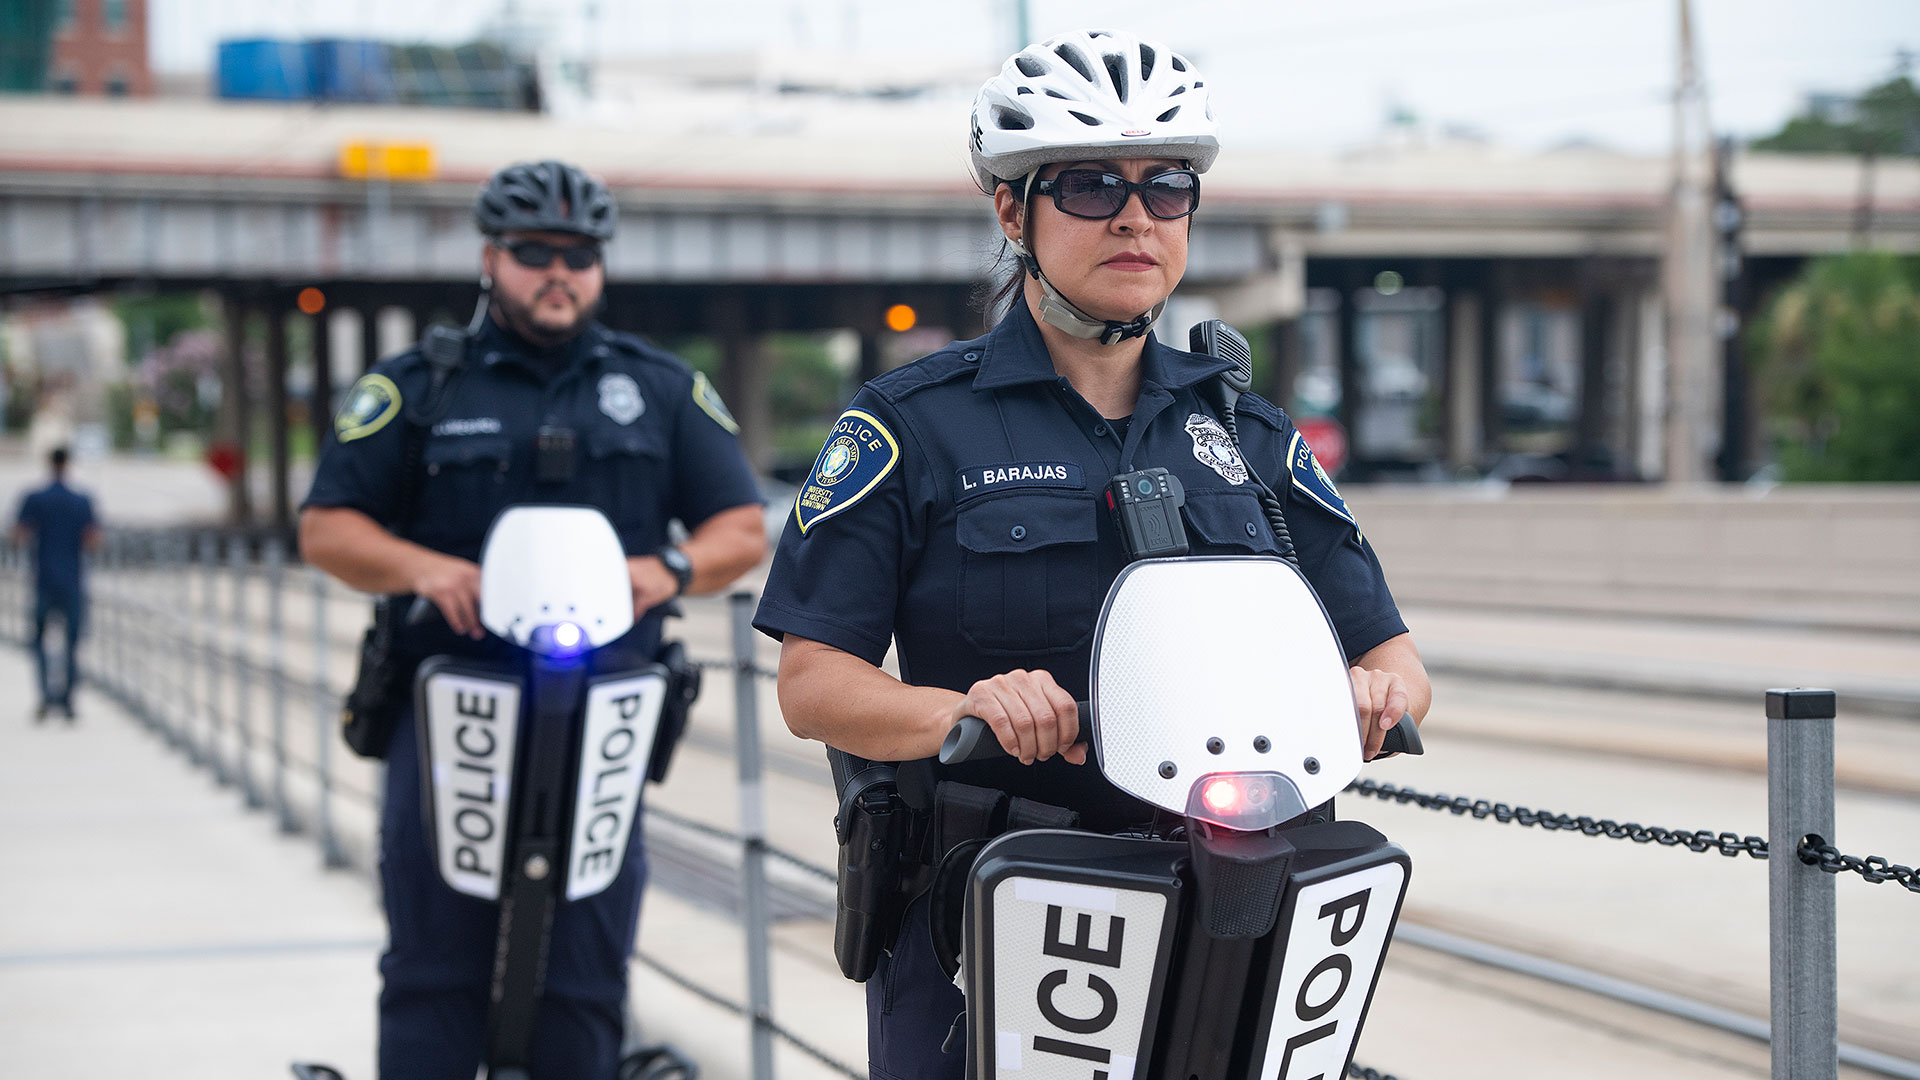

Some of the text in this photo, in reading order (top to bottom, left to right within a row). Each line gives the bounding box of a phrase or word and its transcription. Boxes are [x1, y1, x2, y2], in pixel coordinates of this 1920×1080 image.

[832, 421, 882, 452] POLICE
[962, 465, 1067, 490] L. BARAJAS
[454, 689, 497, 877] POLICE
[579, 693, 641, 878] POLICE
[1032, 904, 1125, 1080] ICE
[1277, 887, 1371, 1080] POL
